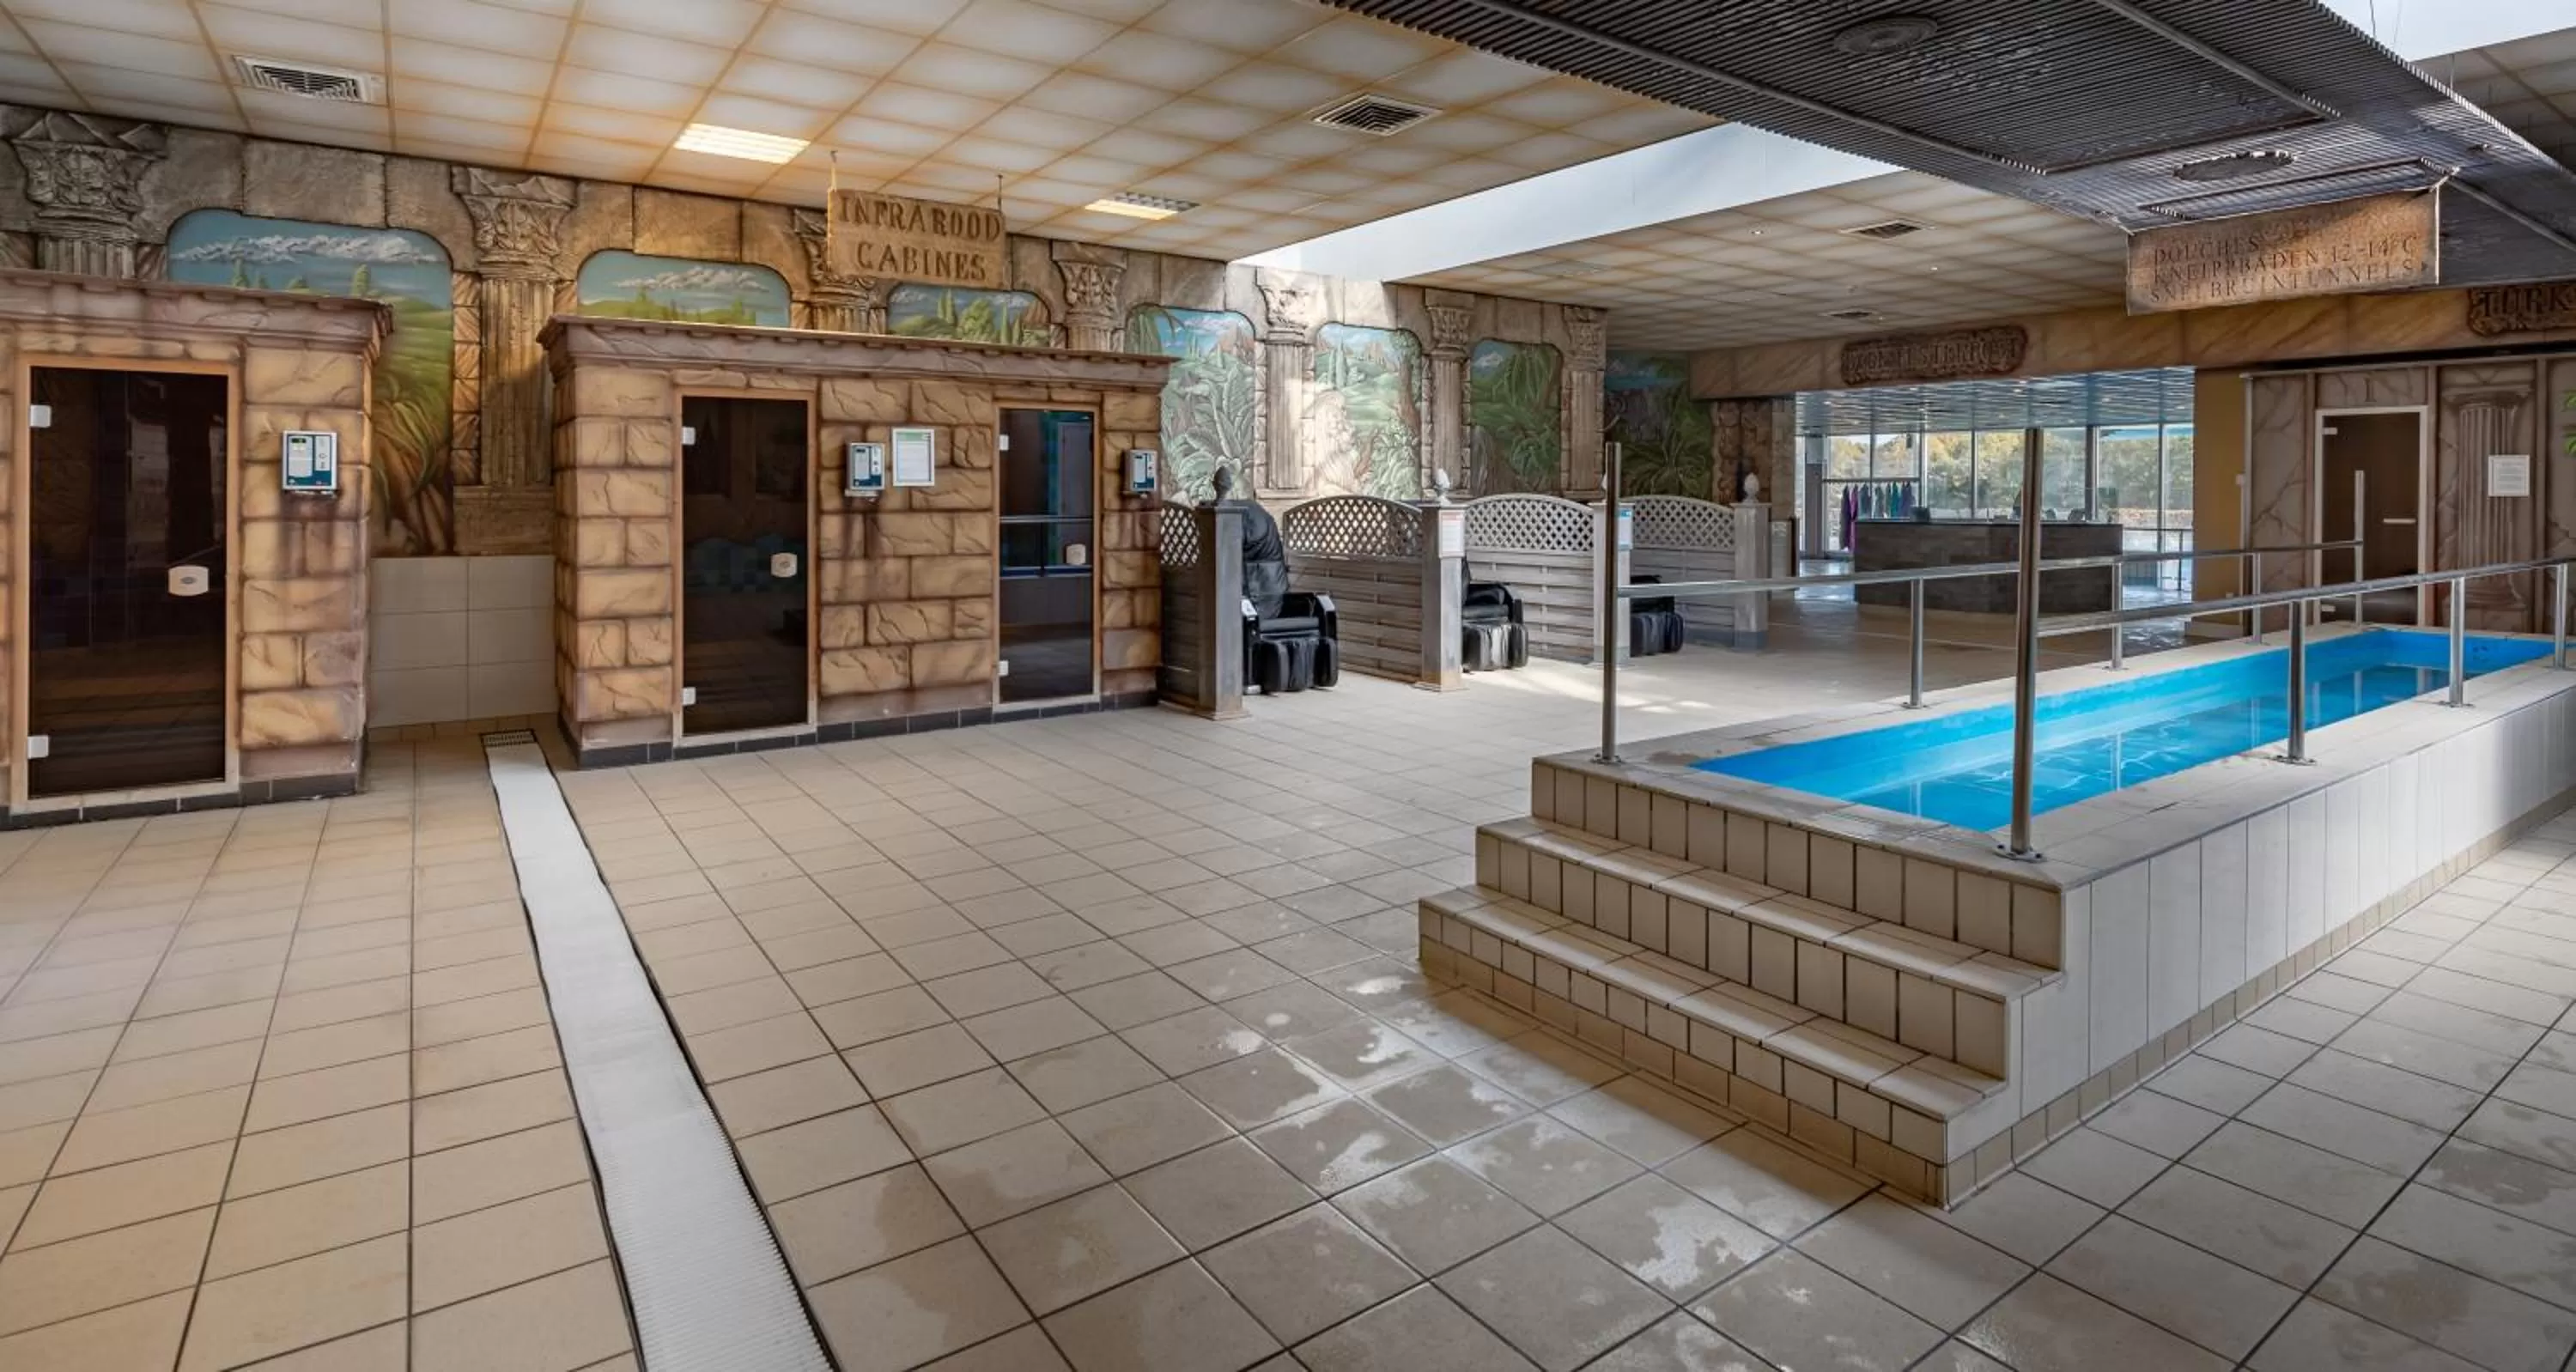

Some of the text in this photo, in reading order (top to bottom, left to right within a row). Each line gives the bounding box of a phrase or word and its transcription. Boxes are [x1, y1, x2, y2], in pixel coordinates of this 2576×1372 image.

[838, 196, 1001, 242] INFRAROOD
[857, 240, 987, 281] CABINES
[2478, 285, 2576, 317] TURK
